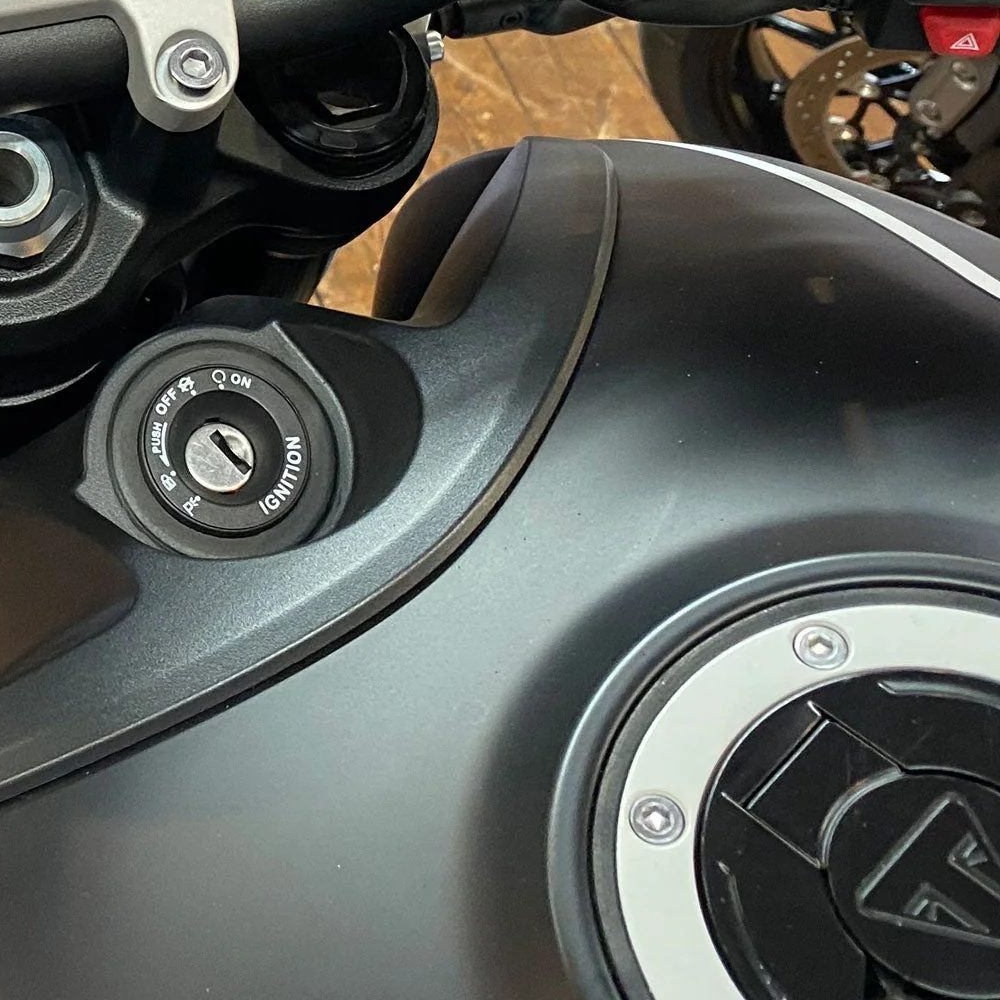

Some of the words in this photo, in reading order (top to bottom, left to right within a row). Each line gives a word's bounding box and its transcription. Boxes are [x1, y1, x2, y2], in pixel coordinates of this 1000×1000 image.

[230, 373, 253, 389] ON
[155, 388, 178, 416] OFF
[151, 421, 163, 454] PUSH
[258, 436, 302, 515] IGNITION
